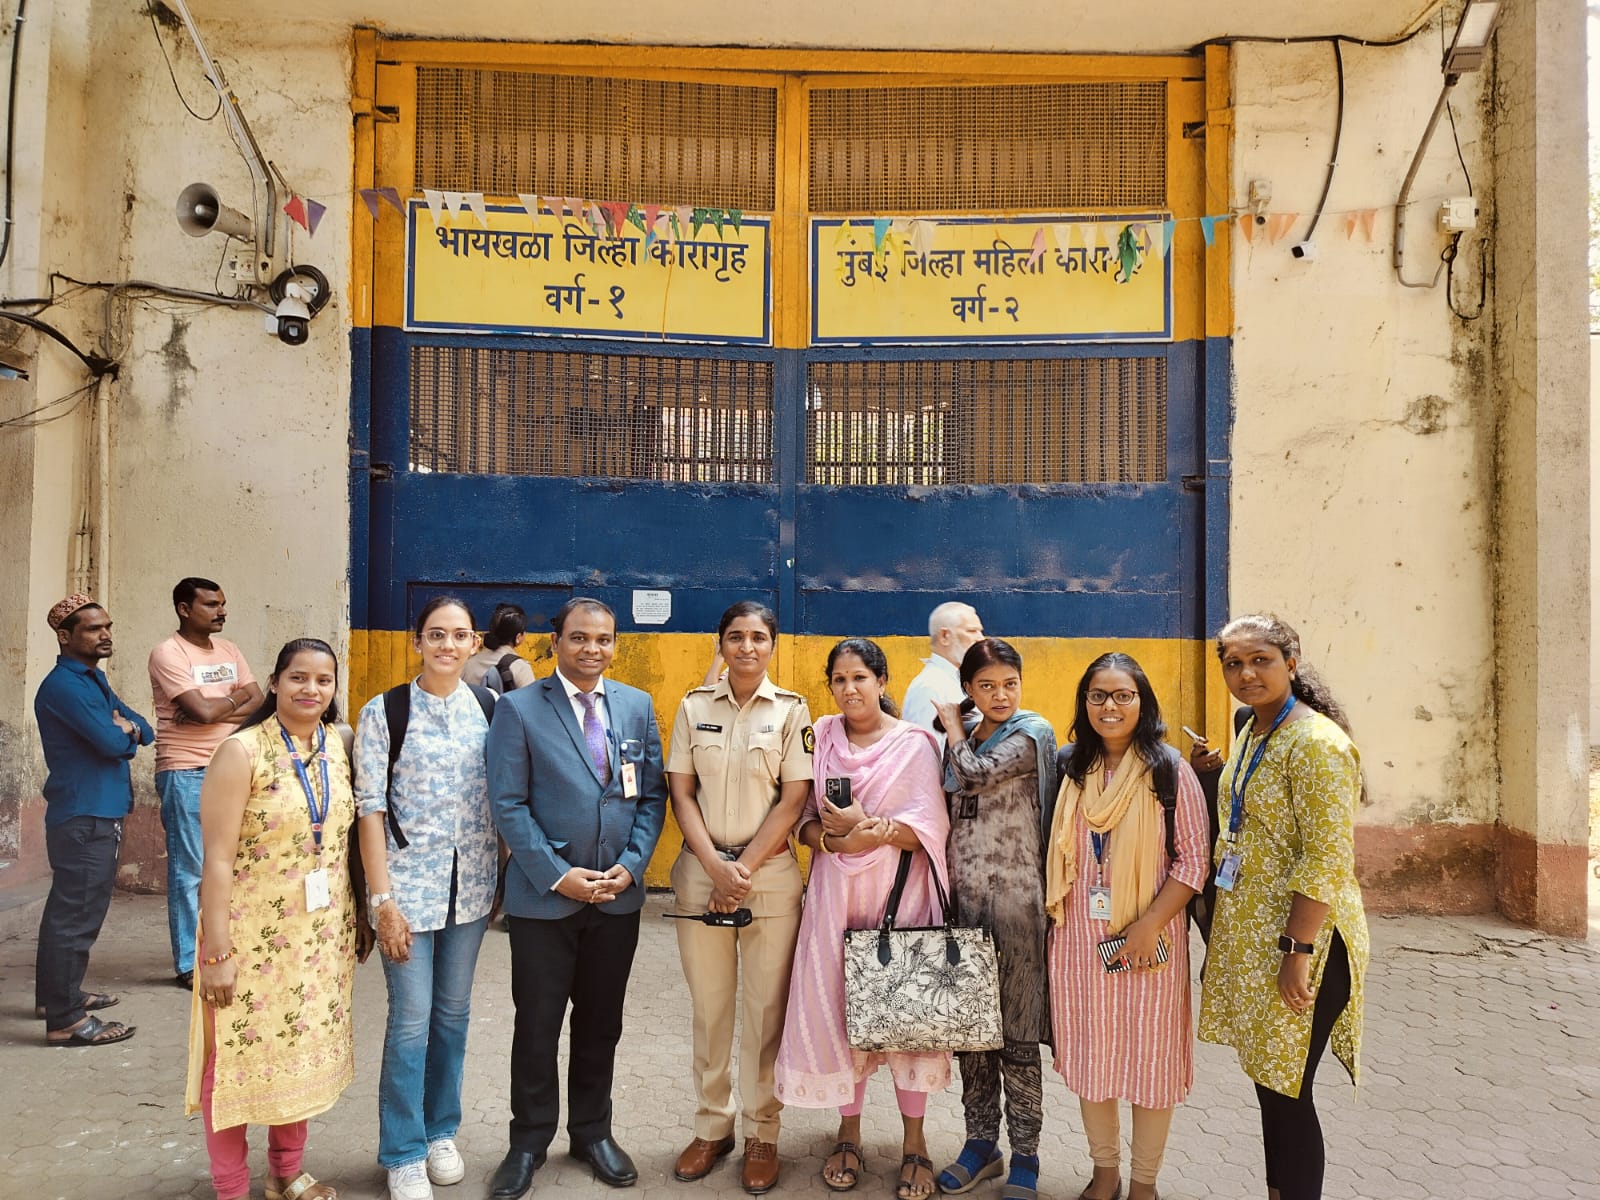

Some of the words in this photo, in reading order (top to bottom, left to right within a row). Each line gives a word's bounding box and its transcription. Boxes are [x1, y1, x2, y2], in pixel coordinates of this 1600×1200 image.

[435, 225, 554, 260] भायखळा
[563, 223, 640, 267] जिल्हा
[650, 239, 749, 282] कारागृह
[973, 239, 1047, 277] महिला
